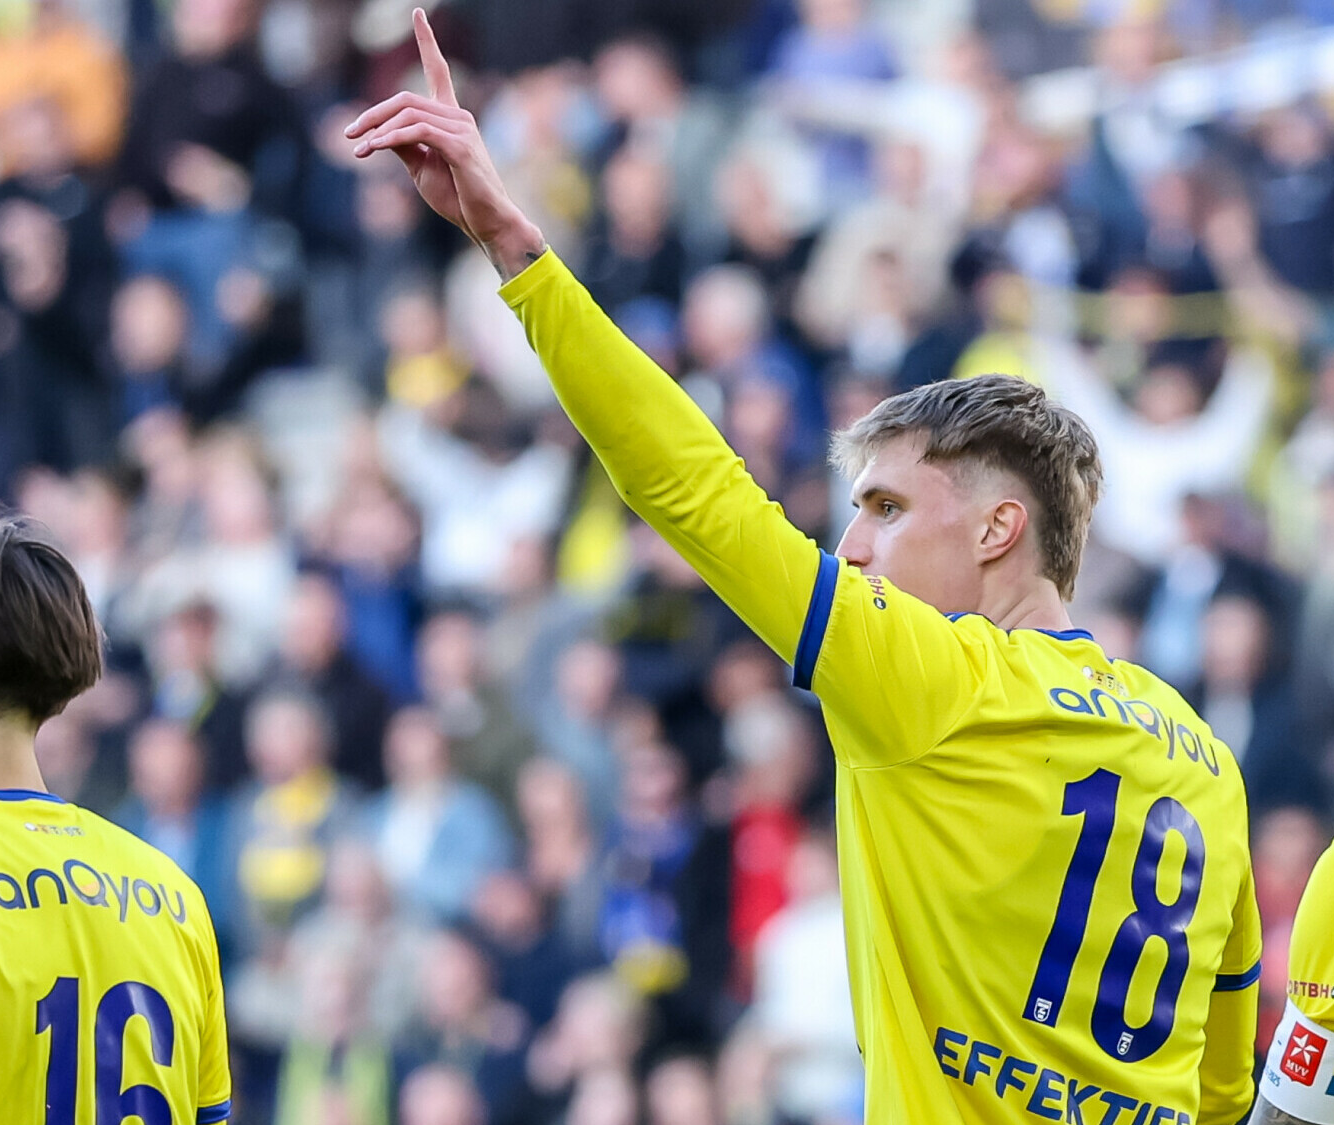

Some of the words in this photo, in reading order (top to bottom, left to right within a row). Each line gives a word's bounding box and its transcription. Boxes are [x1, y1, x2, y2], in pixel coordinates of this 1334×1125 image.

[1049, 687, 1219, 776] anQyou
[1022, 768, 1205, 1063] 18
[1285, 1058, 1310, 1077] MVV
